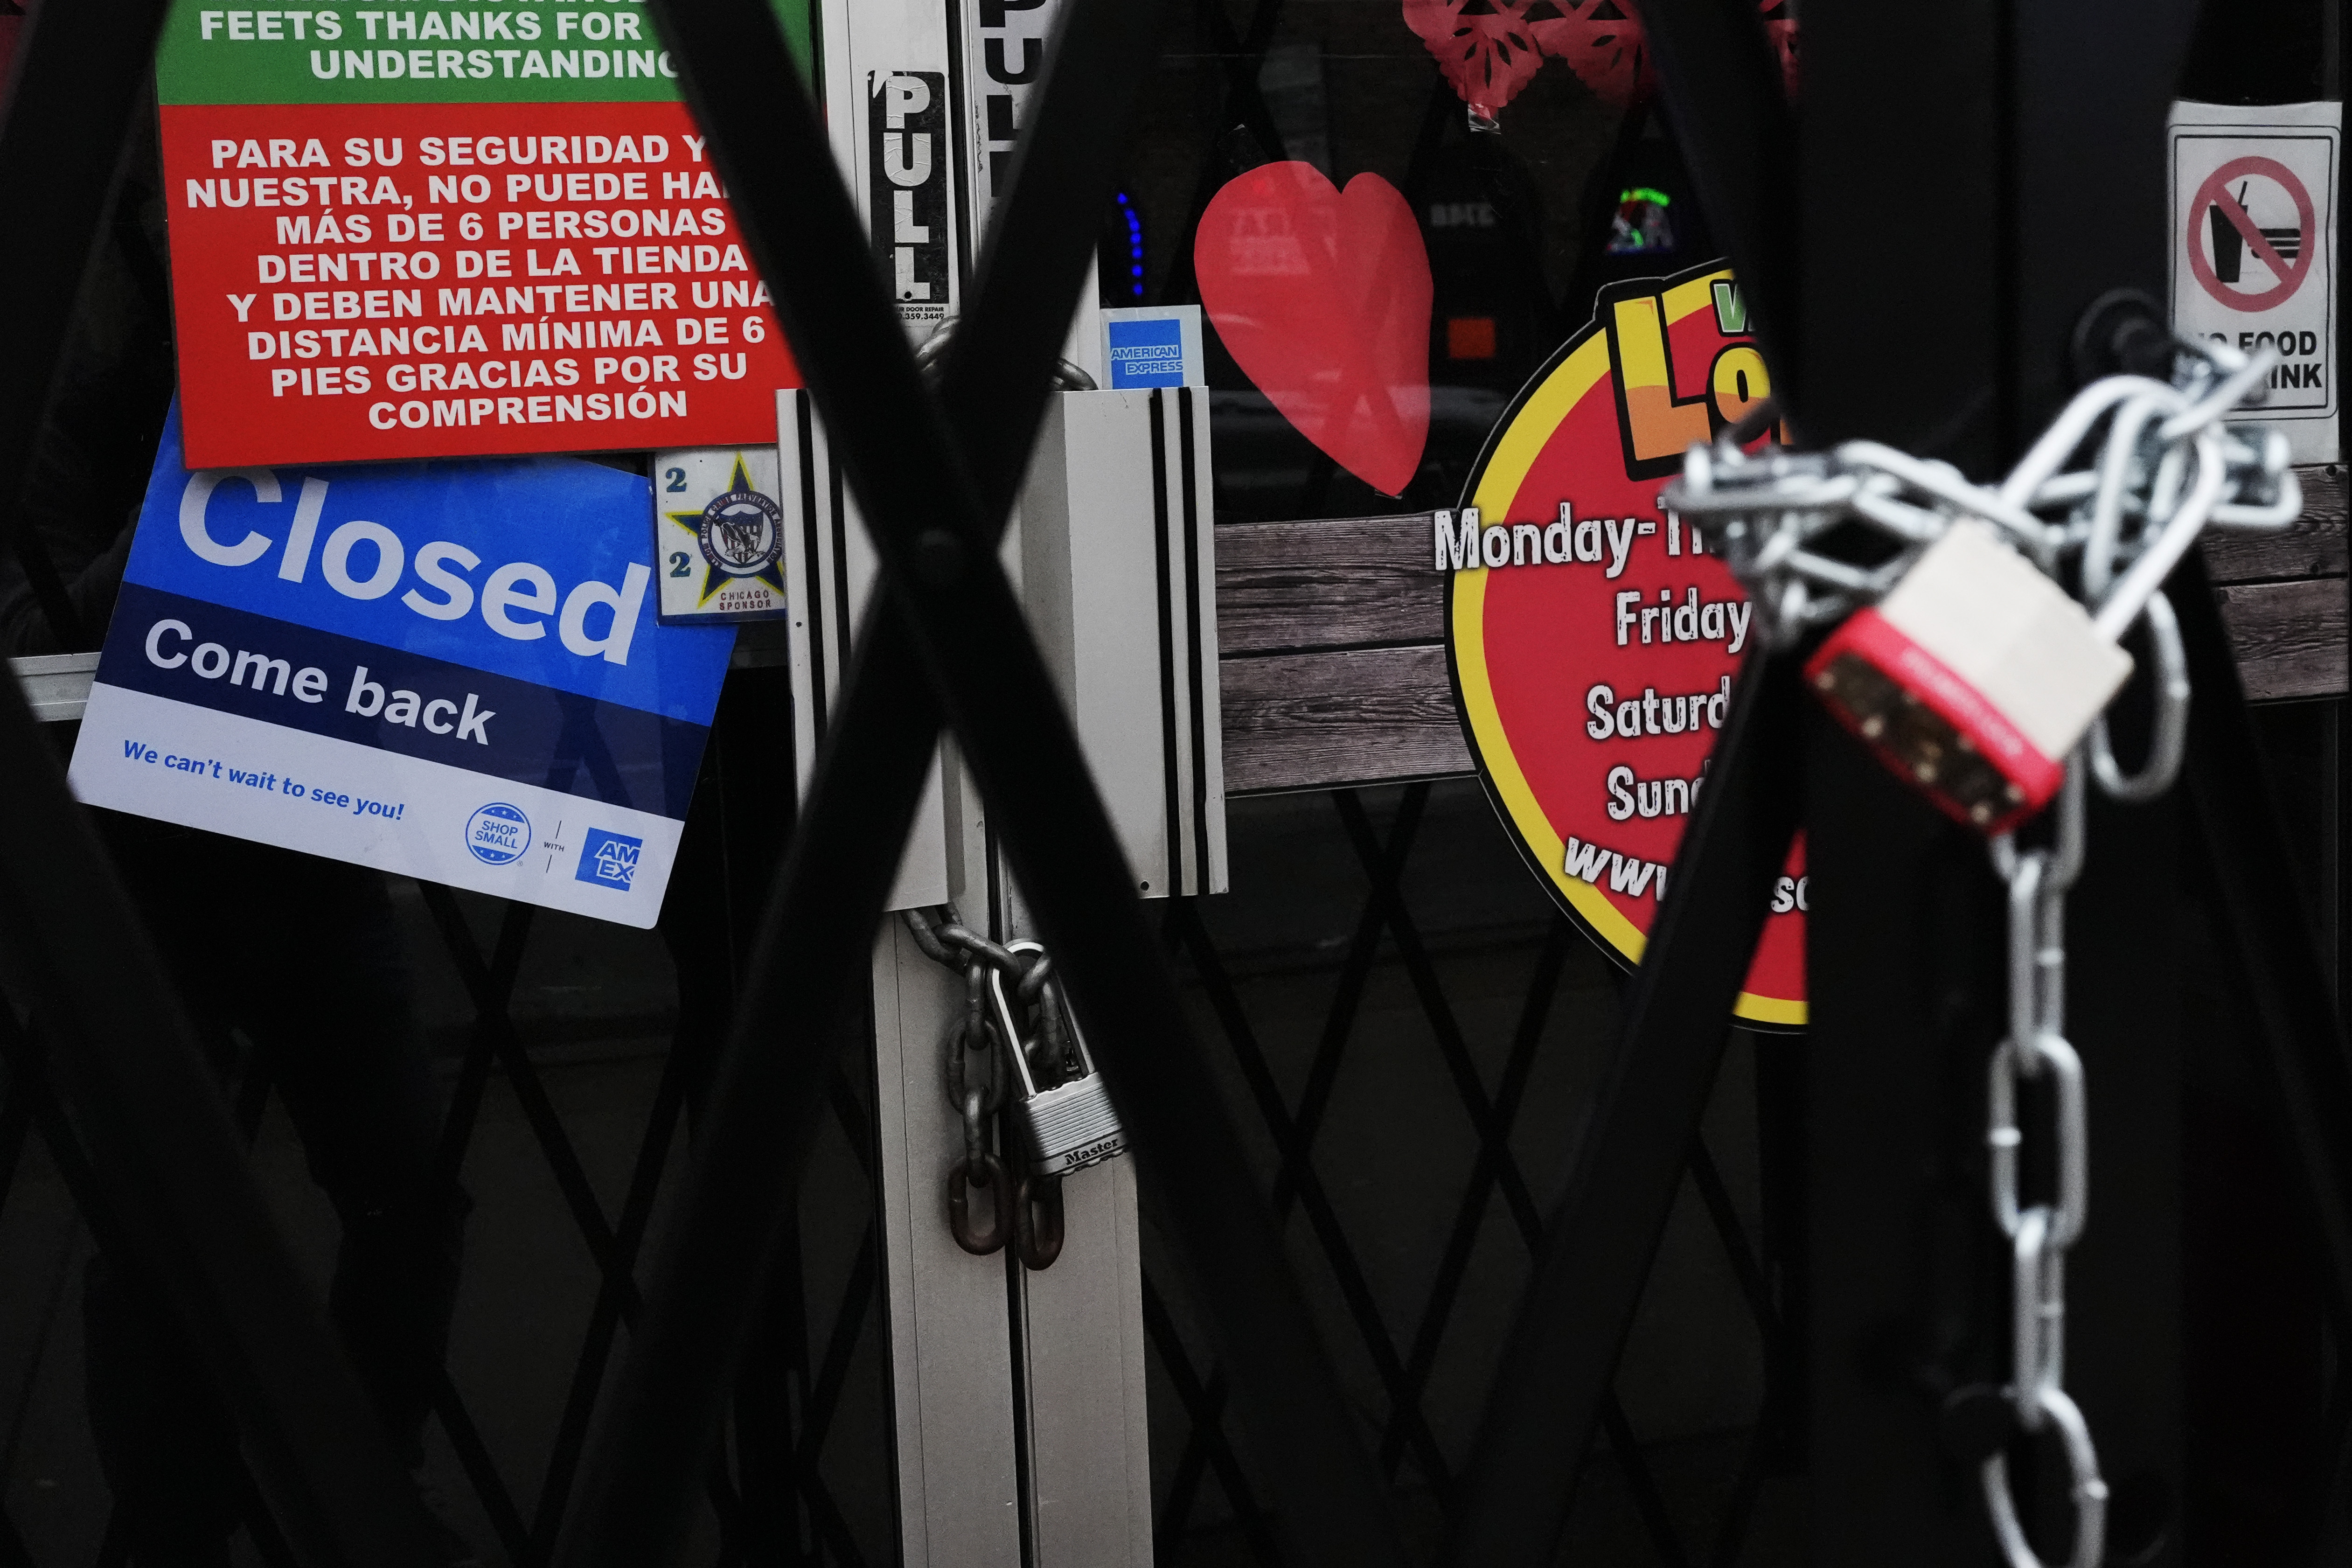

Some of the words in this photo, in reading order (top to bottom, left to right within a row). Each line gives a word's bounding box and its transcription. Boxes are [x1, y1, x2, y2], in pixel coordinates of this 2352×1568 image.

[200, 11, 342, 41] FEETS
[356, 11, 542, 41] THANKS
[556, 12, 642, 41] FOR
[211, 139, 330, 168] PARA
[344, 138, 403, 167] SU
[419, 135, 669, 166] SEGURIDAD
[682, 135, 707, 162] Y
[187, 175, 413, 211] NUESTRA,
[428, 174, 491, 204] NO
[506, 172, 648, 202] PUEDE
[883, 76, 931, 300] PULL
[276, 209, 372, 244] MÁS
[387, 213, 445, 242] DE
[459, 212, 484, 241] 6
[498, 208, 725, 240] PERSONAS
[257, 251, 440, 284] DENTRO
[456, 249, 512, 279] DE
[527, 248, 581, 277] LA
[593, 244, 748, 275] TIENDA
[226, 293, 257, 322] Y
[273, 289, 422, 321] DEBEN
[438, 281, 679, 316] MANTENER
[691, 280, 775, 307] UNA
[248, 325, 488, 360] DISTANCIA
[502, 317, 663, 351] MÍNIMA
[676, 317, 730, 345] DE
[742, 316, 765, 343] 6
[1111, 346, 1177, 359] AMERICAN
[2239, 331, 2317, 356] FOOD
[271, 366, 371, 397] PIES
[386, 358, 579, 392] GRACIAS
[594, 355, 681, 385] POR
[693, 352, 747, 381] SU
[1127, 361, 1183, 373] EXPRESS
[2271, 363, 2322, 389] INK
[369, 386, 687, 430] COMPRENSIÓN
[666, 467, 687, 492] 2
[179, 468, 651, 666] Closed
[669, 552, 691, 577] 2
[719, 599, 771, 611] SPONSOR
[720, 590, 769, 600] CHICAGO
[1616, 587, 1753, 654] Friday
[145, 619, 328, 704] Come
[345, 666, 496, 746] back
[1587, 676, 1731, 740] Saturd
[124, 739, 158, 764] We
[164, 754, 223, 779] can’t
[229, 768, 277, 792] wait
[283, 778, 306, 798] to
[311, 787, 350, 808] see
[353, 797, 405, 821] you!
[474, 830, 518, 850] SMALL
[481, 820, 518, 836] SHOP
[543, 842, 565, 852] WITH
[598, 842, 640, 865] AM
[599, 859, 635, 883] EX
[1065, 1138, 1119, 1165] Master
